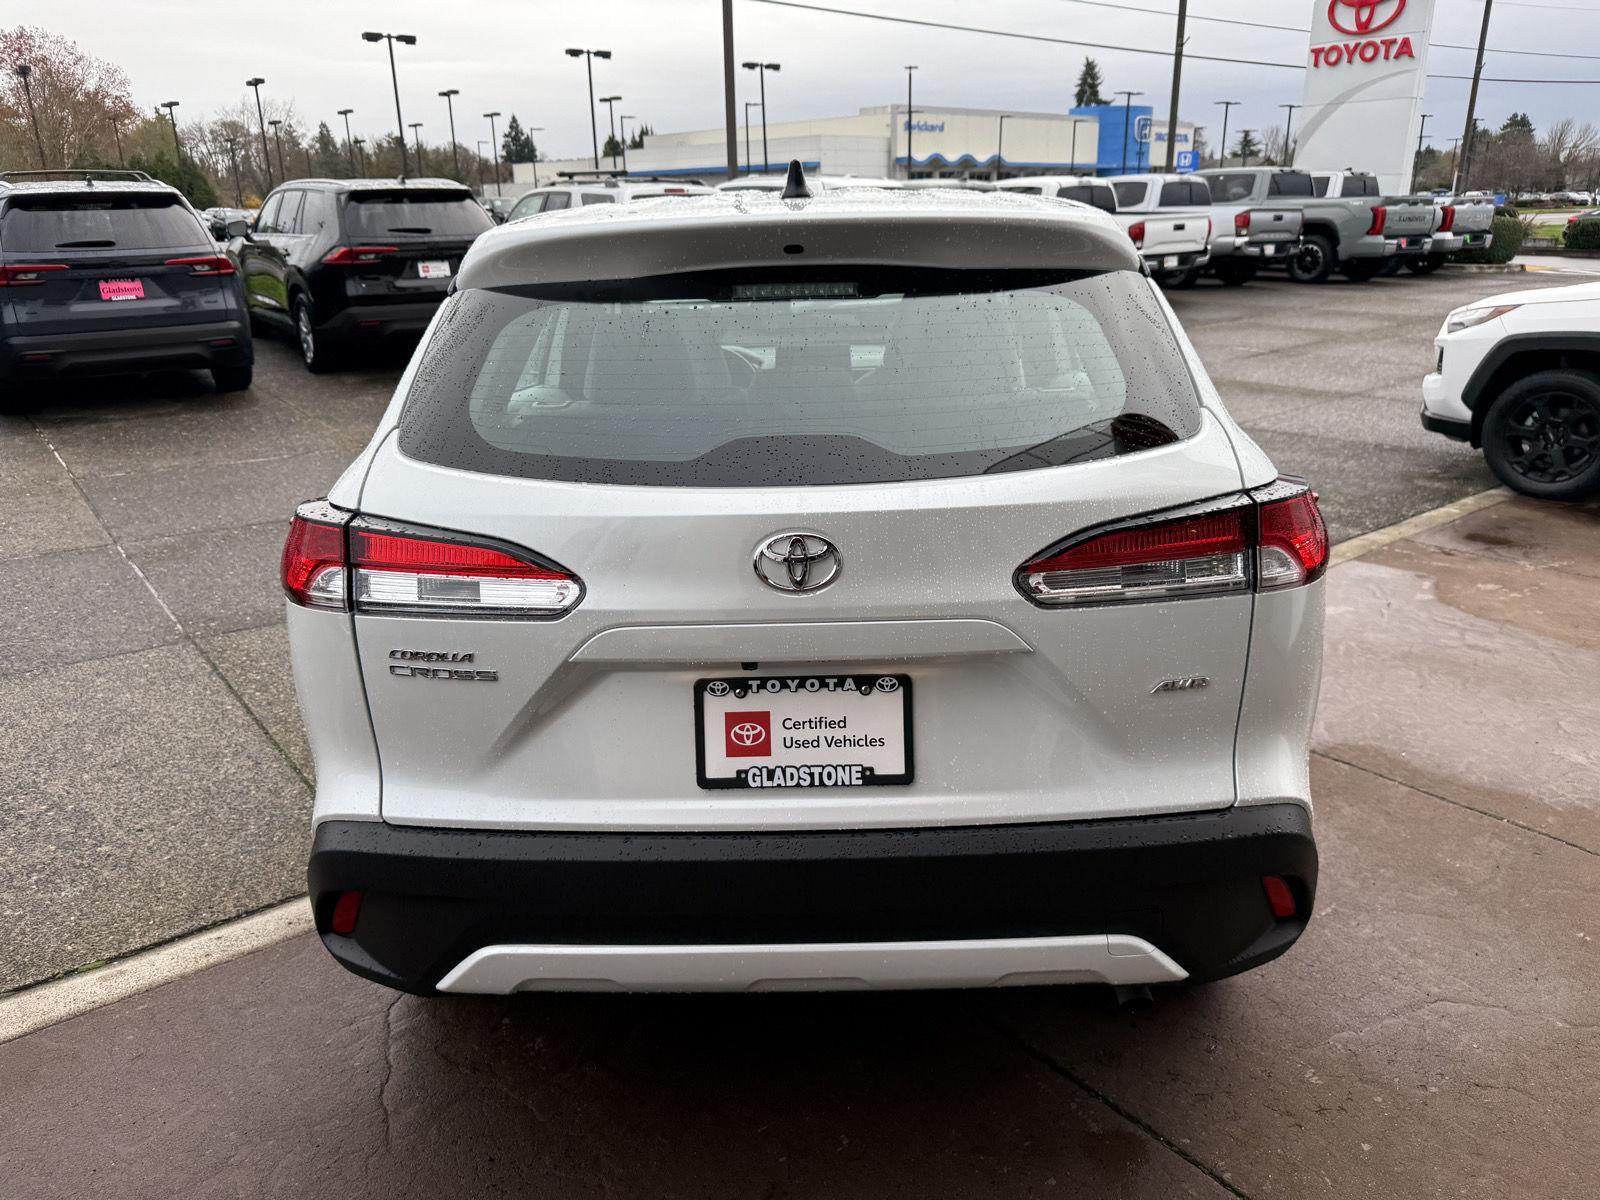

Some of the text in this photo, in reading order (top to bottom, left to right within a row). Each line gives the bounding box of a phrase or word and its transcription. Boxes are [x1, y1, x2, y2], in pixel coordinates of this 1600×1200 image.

[1310, 36, 1415, 68] TOYOTA
[101, 286, 142, 294] Gladstone
[388, 649, 475, 663] COROLLA
[389, 664, 500, 682] CROSS
[748, 677, 857, 693] TOYOTA
[1150, 676, 1210, 694] AWD
[782, 716, 847, 730] Certified
[783, 734, 885, 749] Used Vehicles
[747, 764, 863, 788] GLADSTONE
